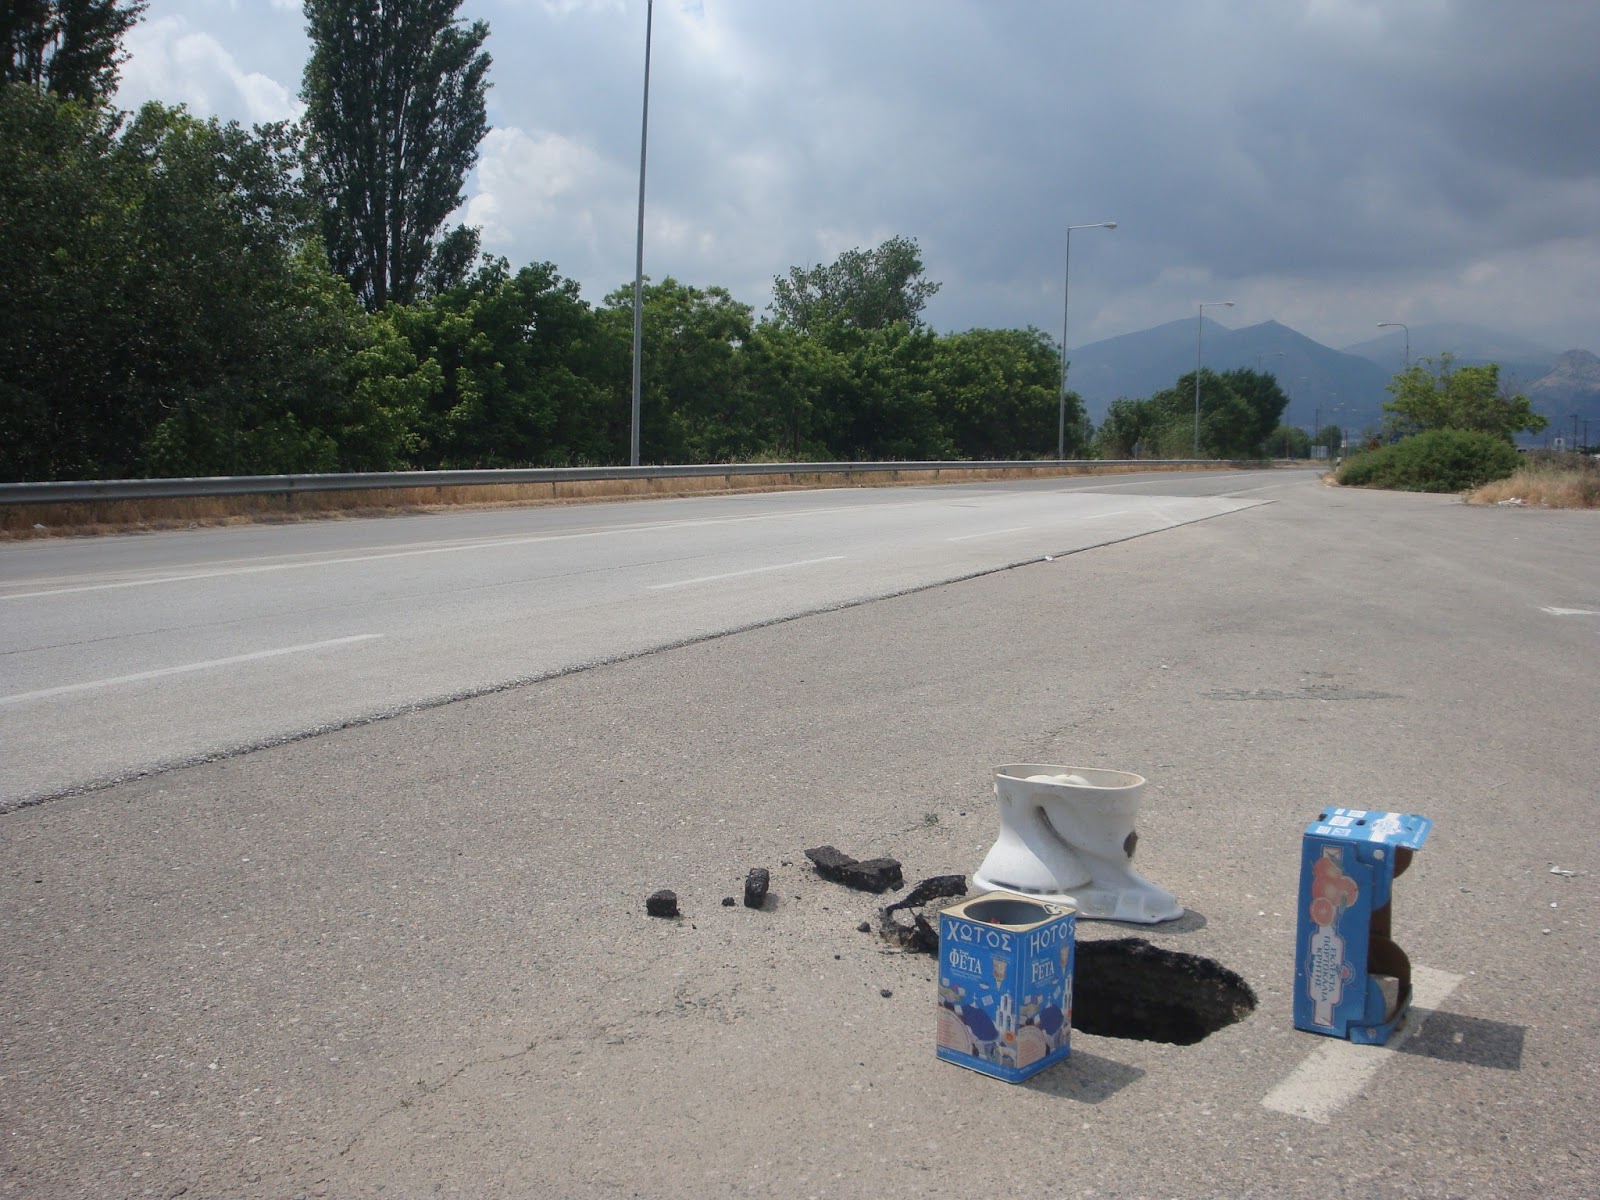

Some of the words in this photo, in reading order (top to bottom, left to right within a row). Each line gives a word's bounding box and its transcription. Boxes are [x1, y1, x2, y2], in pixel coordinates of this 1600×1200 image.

[947, 921, 1012, 952] ΧΩΤΟΣ
[1030, 919, 1074, 957] HOTOS
[949, 948, 982, 975] ΦΕΤΑ
[1032, 961, 1055, 983] FETA
[1314, 947, 1323, 988] ΚΡΗΤΗΣ
[1321, 936, 1331, 1002] ΠΟΡΤΟΚΑΛΙΑ
